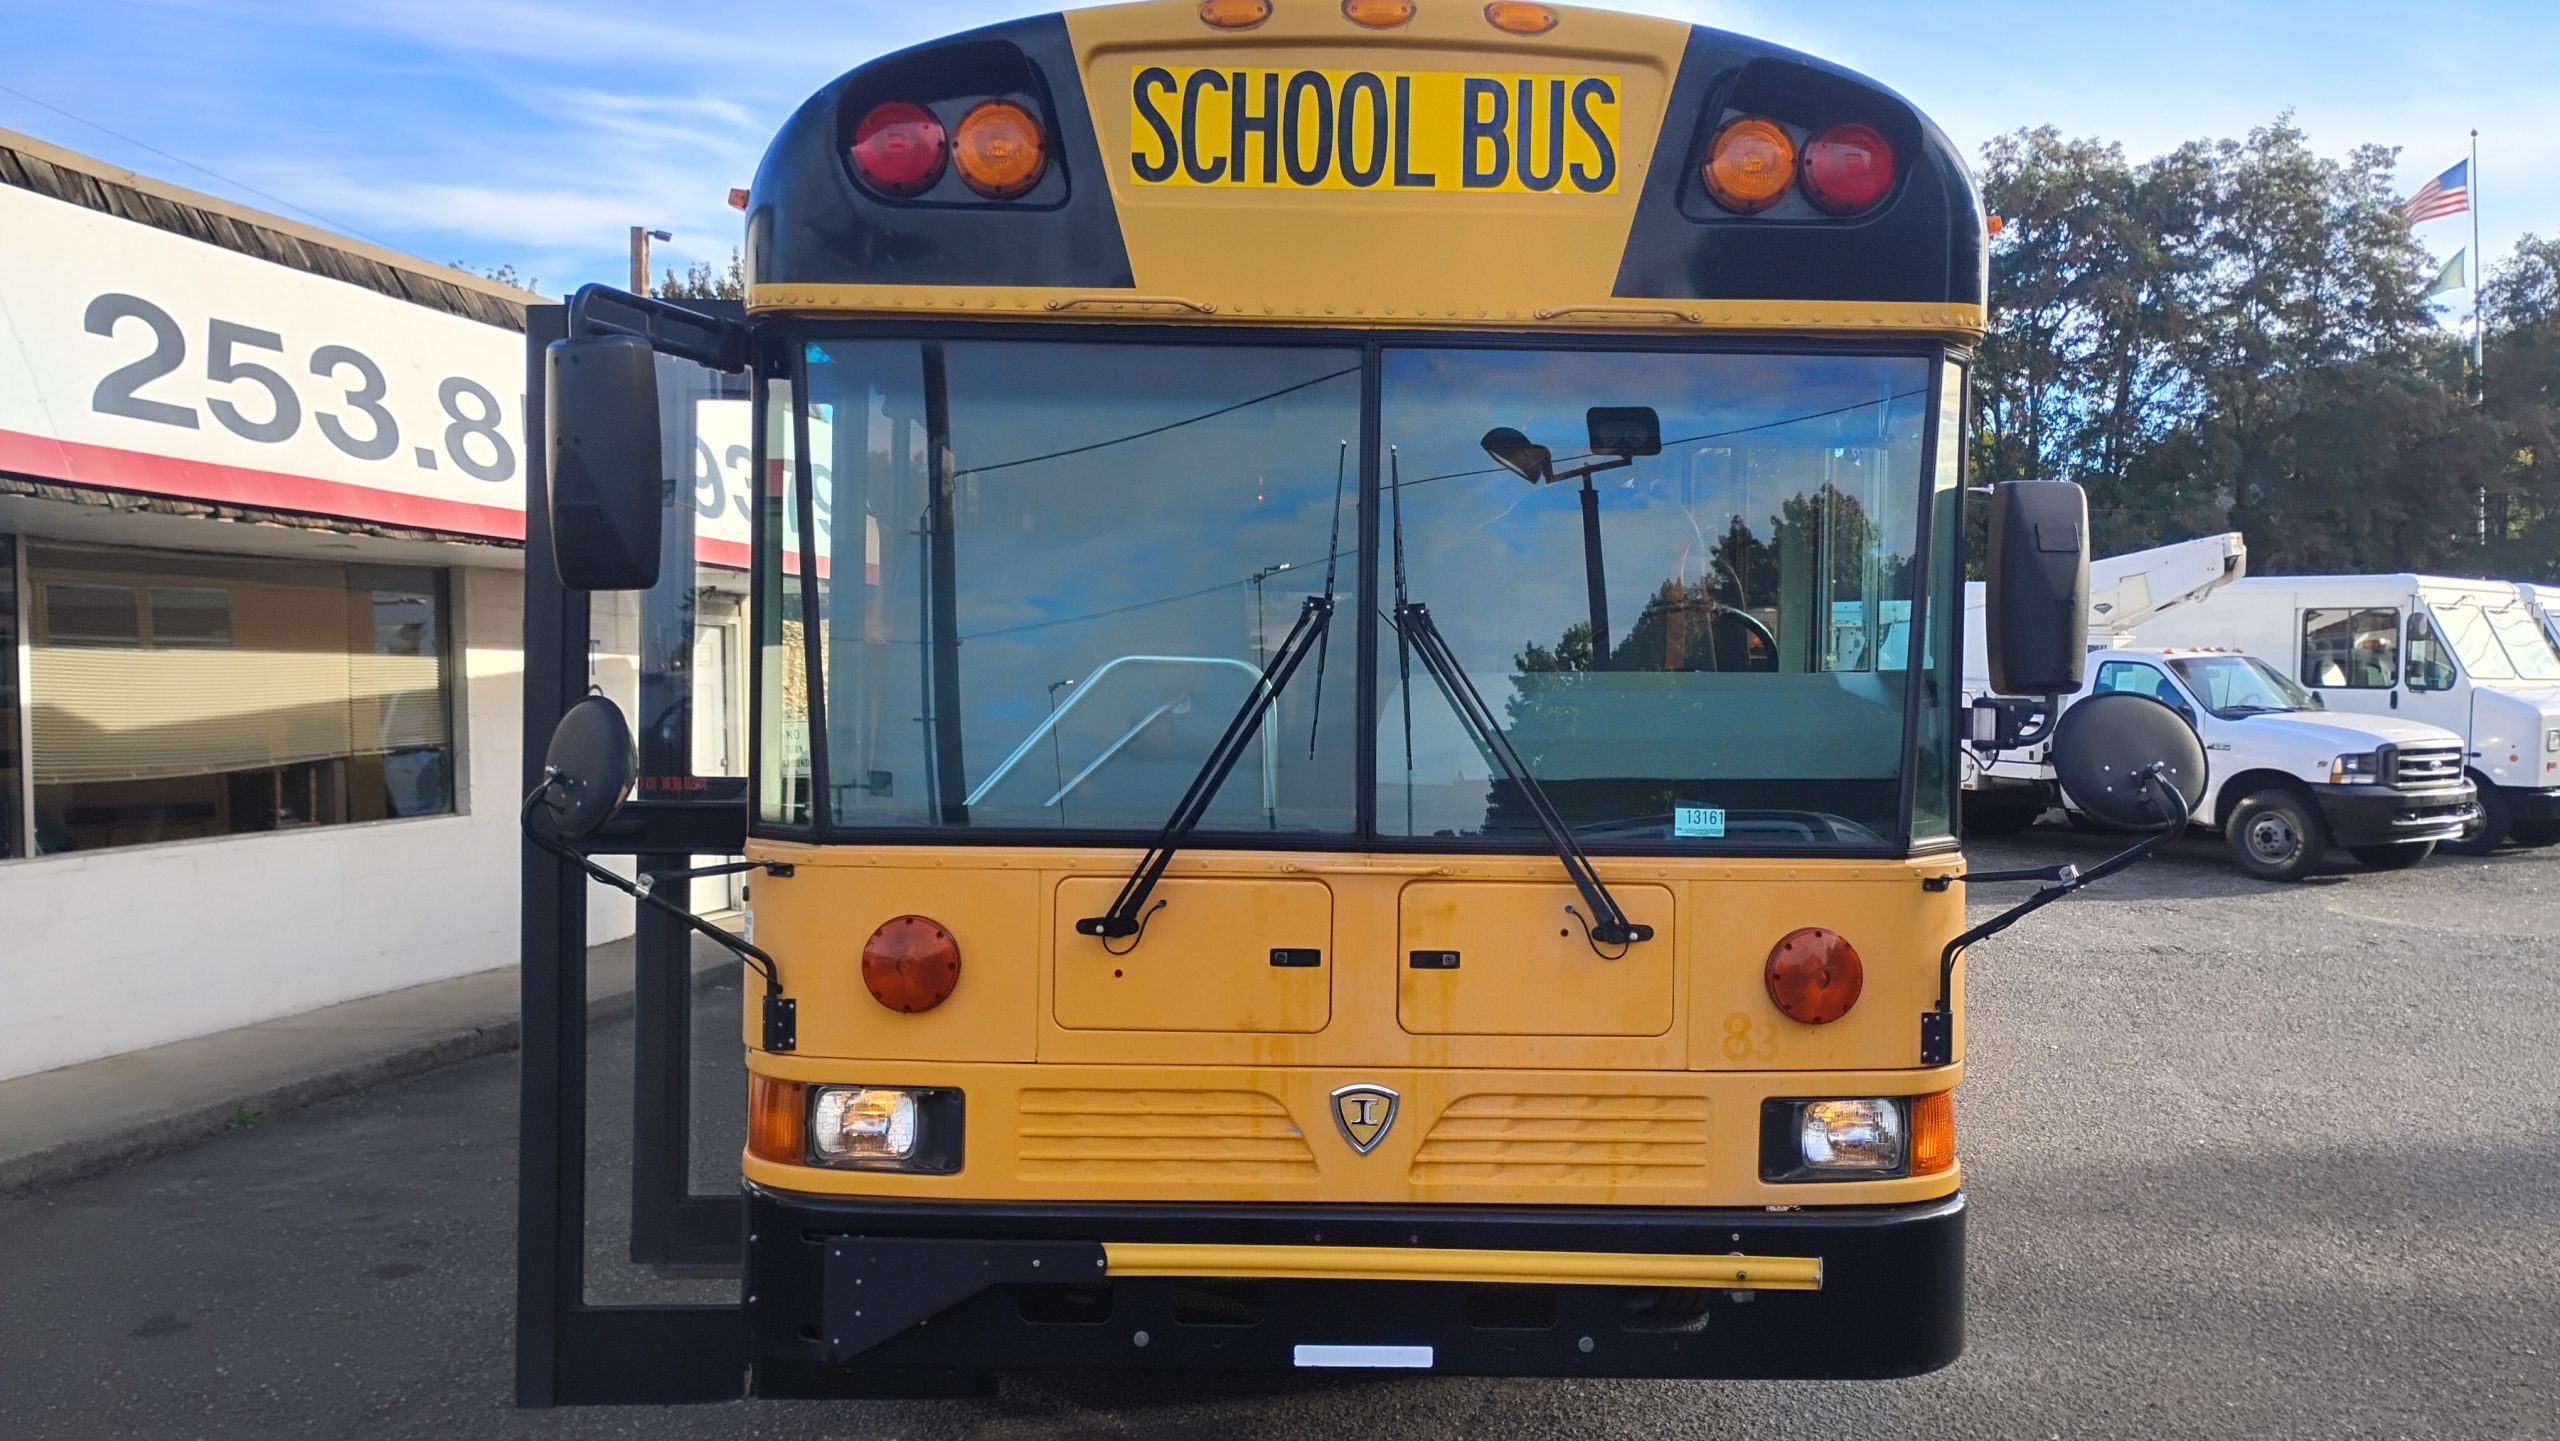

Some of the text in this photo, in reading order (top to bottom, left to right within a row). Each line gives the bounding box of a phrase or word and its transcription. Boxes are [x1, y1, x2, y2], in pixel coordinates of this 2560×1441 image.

[1132, 67, 1616, 193] SCHOOL BUS
[84, 293, 526, 482] 253.8
[786, 729, 800, 740] NO
[1686, 810, 1723, 825] 13161
